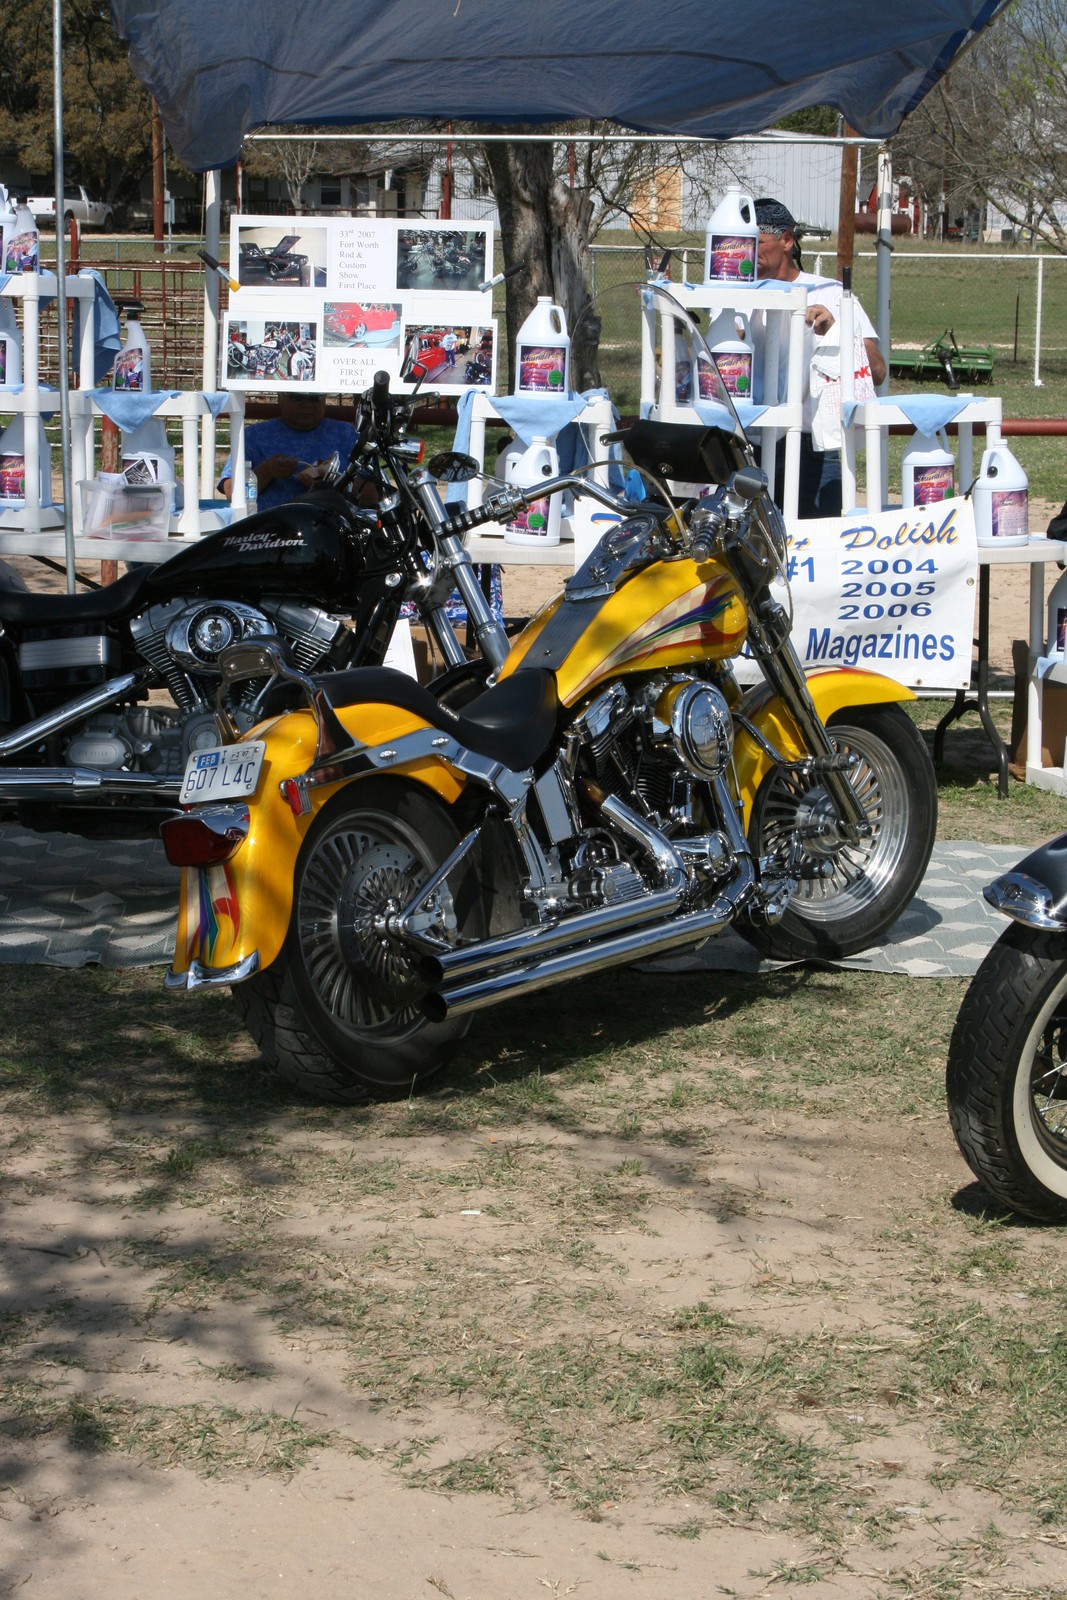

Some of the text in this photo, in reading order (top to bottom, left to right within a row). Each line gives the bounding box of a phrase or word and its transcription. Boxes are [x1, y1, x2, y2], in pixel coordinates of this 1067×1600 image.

[357, 230, 376, 239] 2007
[339, 240, 379, 249] Fort Worth
[339, 250, 364, 259] Rod &
[339, 261, 367, 269] Custom
[338, 271, 359, 279] Show
[339, 281, 377, 290] First Place
[333, 358, 376, 366] OVER ALL
[340, 368, 364, 377] FIRST
[339, 378, 368, 387] PLACE
[238, 538, 307, 552] Davidson
[787, 555, 815, 583] #1
[840, 558, 939, 576] 2004
[840, 581, 936, 598] 2005
[837, 601, 932, 620] 2006
[805, 624, 955, 666] Magazines
[200, 754, 216, 766] FEB
[186, 761, 256, 792] 607 L4C
